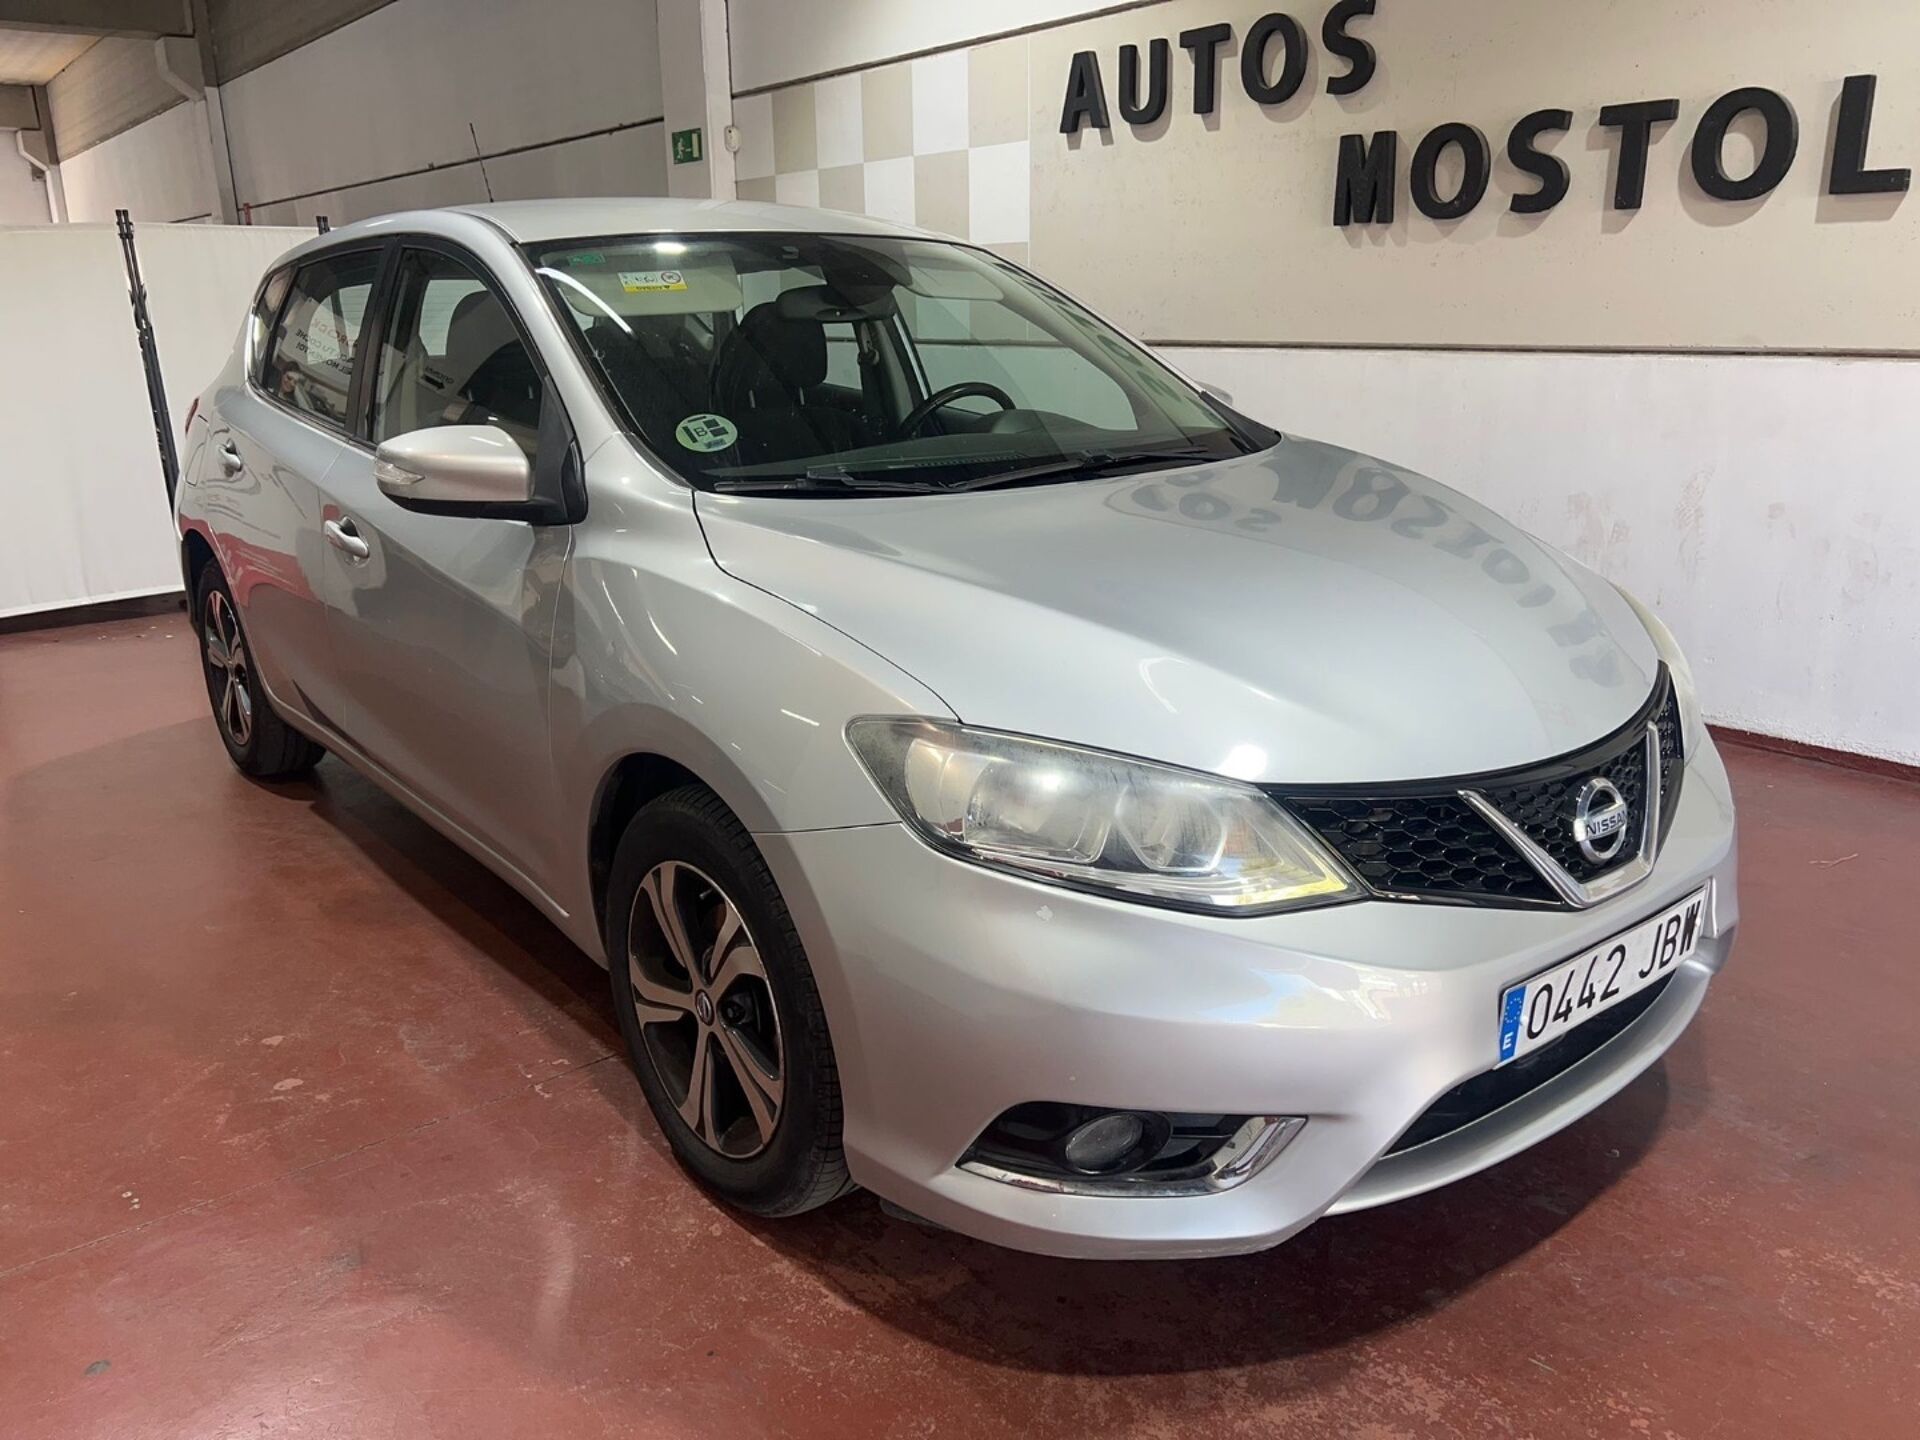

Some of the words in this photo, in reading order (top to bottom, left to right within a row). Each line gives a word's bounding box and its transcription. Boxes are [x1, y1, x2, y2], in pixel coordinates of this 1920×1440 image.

[1059, 0, 1377, 134] AUTOS
[1333, 74, 1911, 226] MOSTOL
[1586, 809, 1627, 836] NISSAN
[1526, 944, 1627, 1040] 0442
[1638, 900, 1701, 979] JBW
[1502, 1032, 1513, 1050] E
